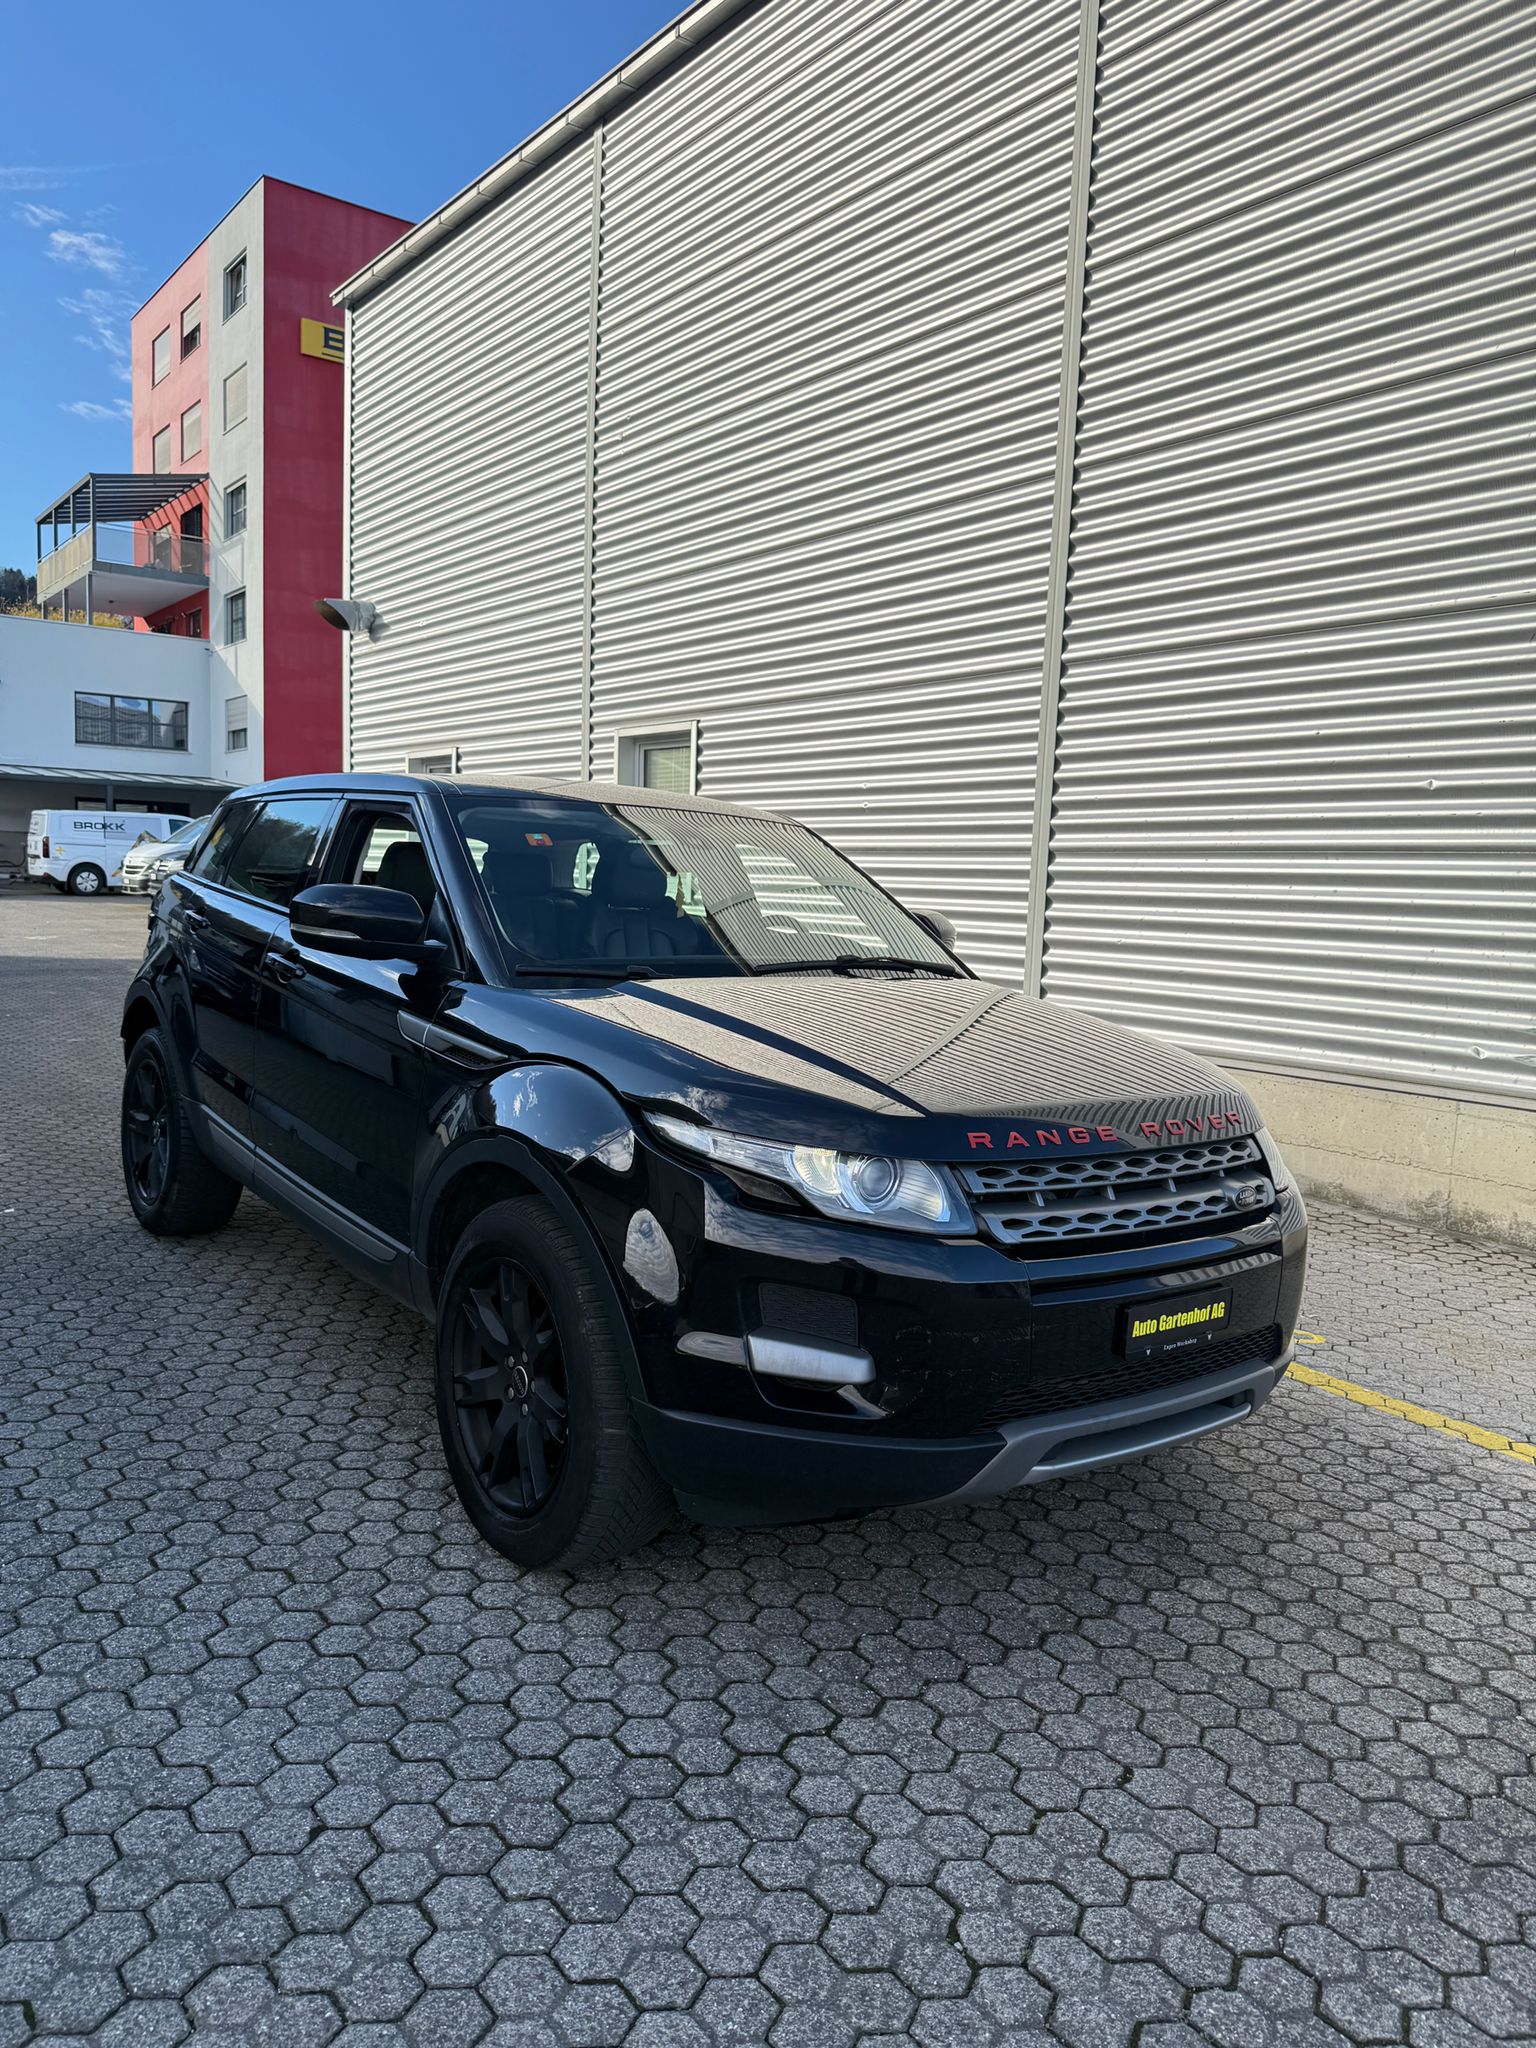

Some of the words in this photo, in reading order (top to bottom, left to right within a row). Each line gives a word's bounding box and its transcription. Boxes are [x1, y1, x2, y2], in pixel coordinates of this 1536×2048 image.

[73, 821, 126, 831] BROKK
[967, 1126, 1117, 1149] RANGE
[1140, 1111, 1242, 1137] ROVER
[1132, 1319, 1157, 1337] Auto
[1159, 1305, 1211, 1331] Gartenhof
[1211, 1302, 1225, 1320] AG
